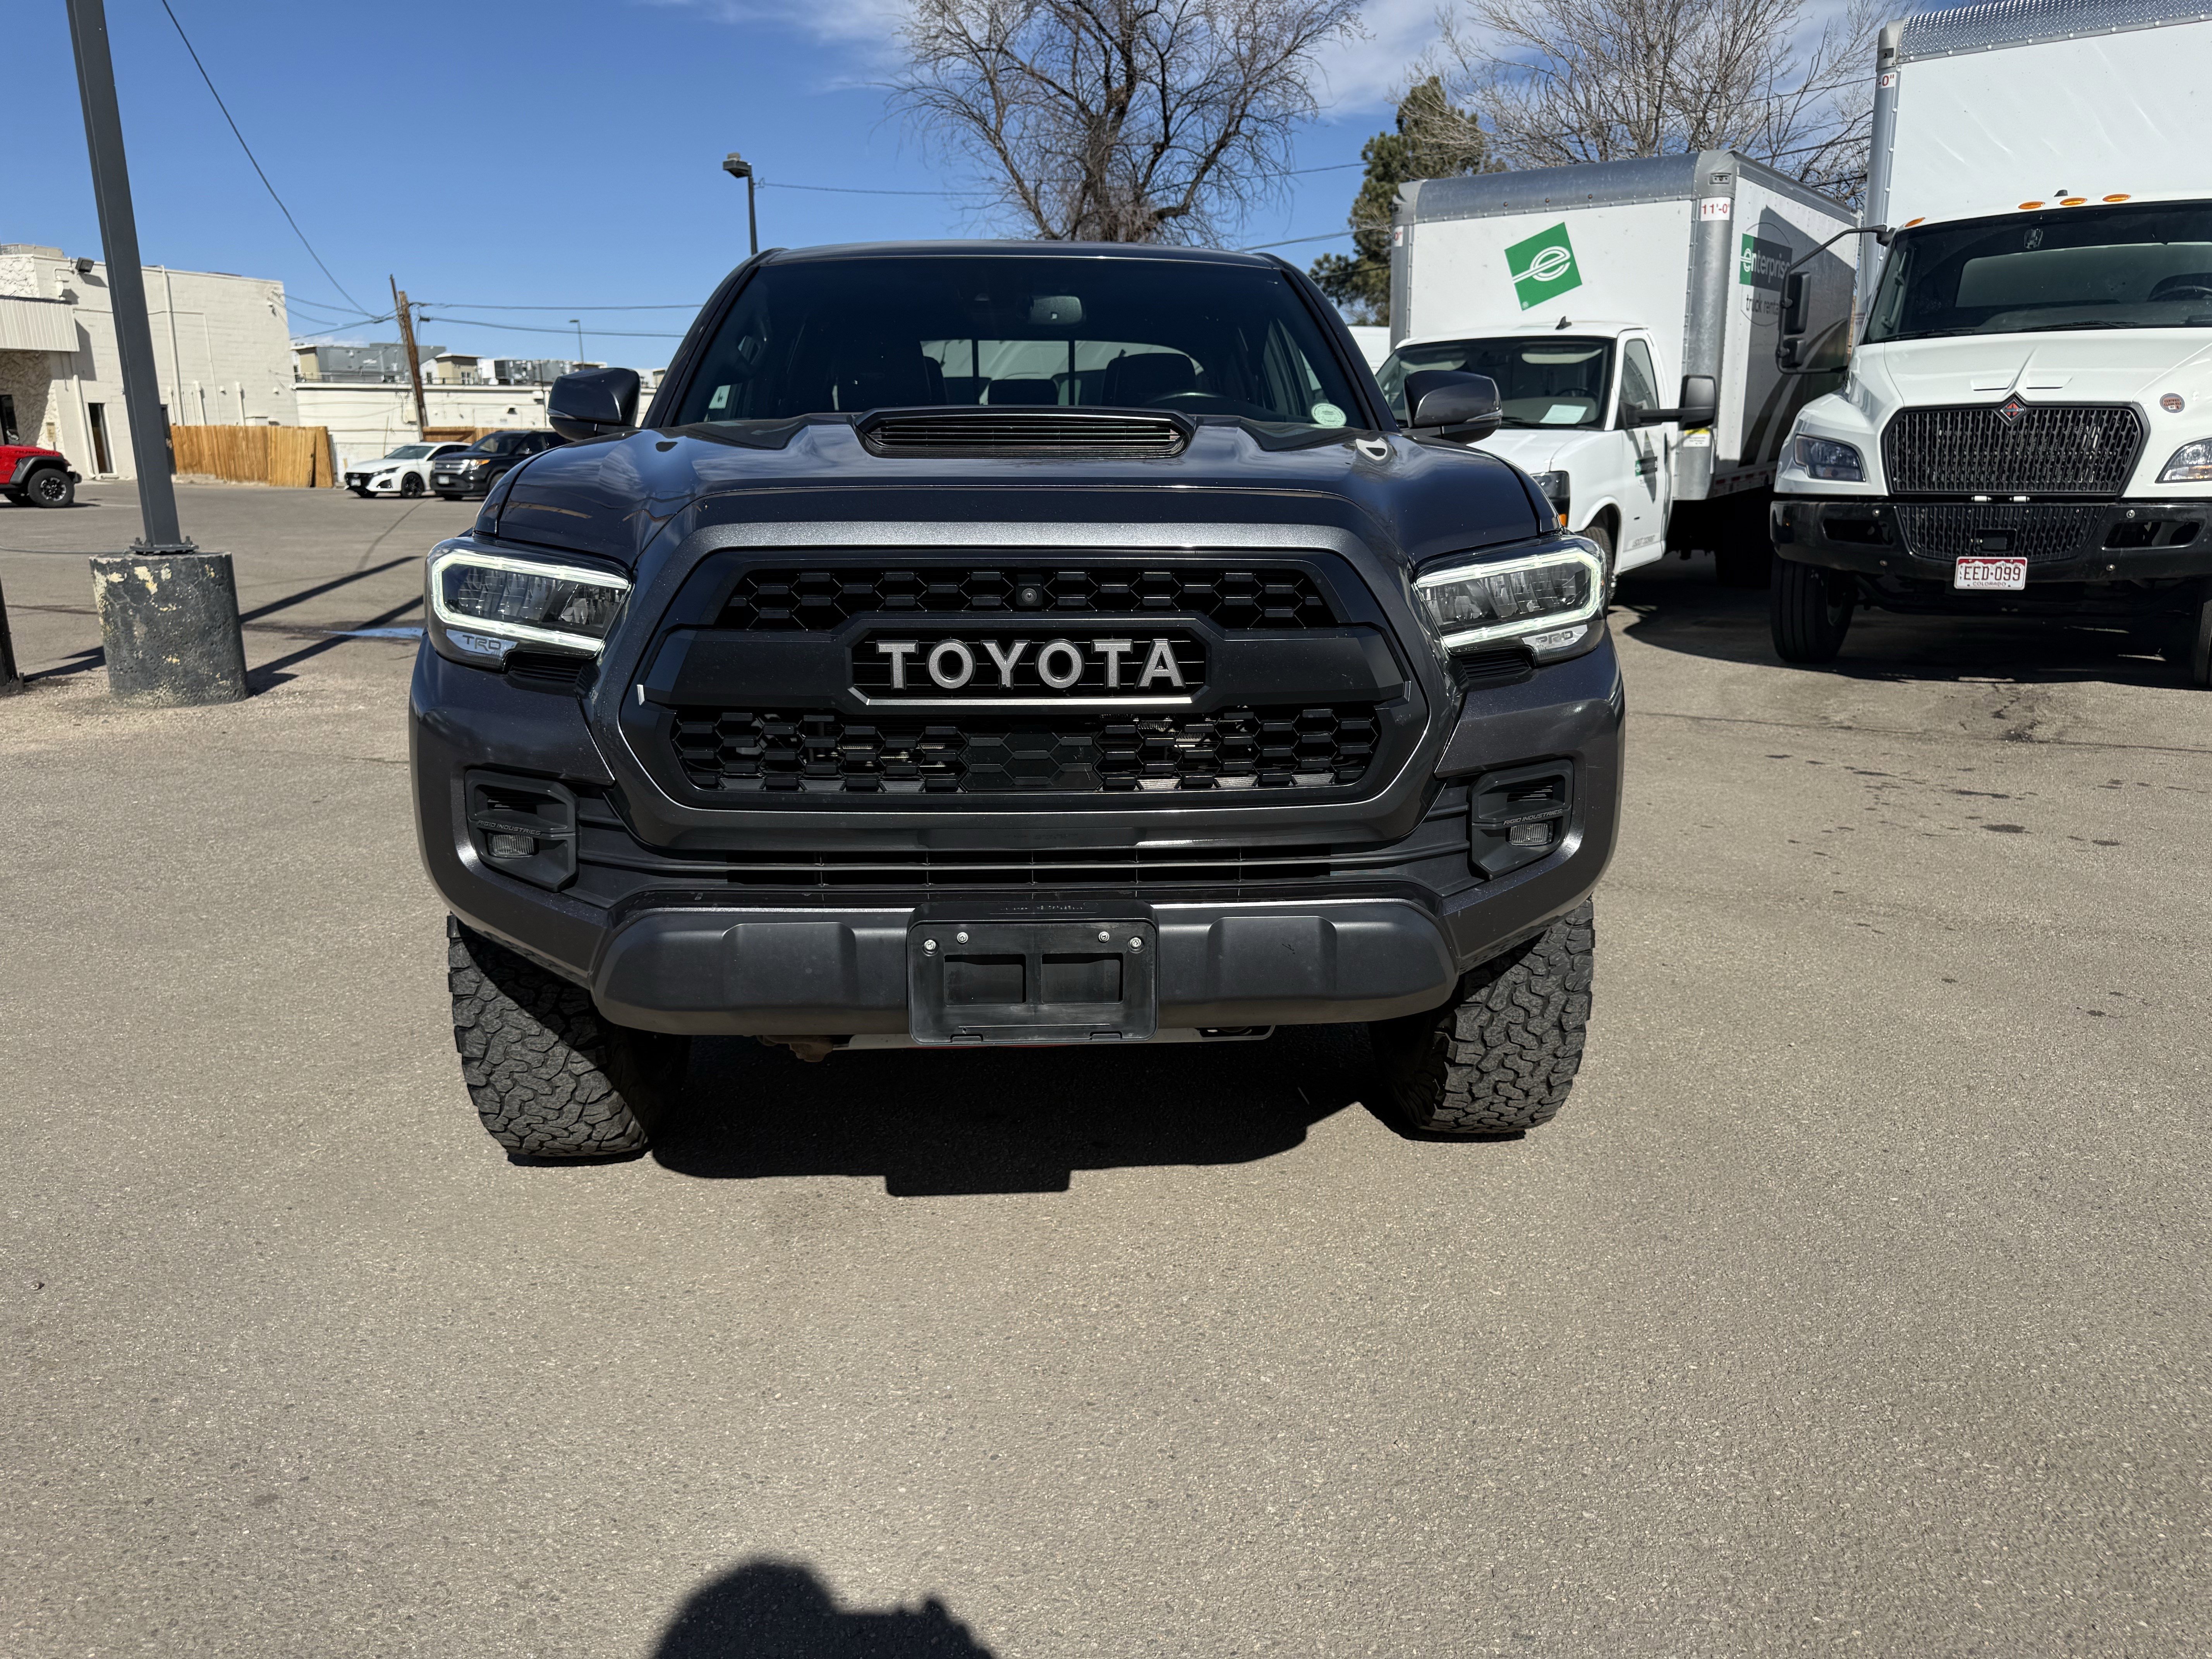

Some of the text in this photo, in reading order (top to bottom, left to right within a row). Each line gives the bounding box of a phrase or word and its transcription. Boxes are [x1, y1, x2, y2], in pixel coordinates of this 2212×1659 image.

[1746, 293, 1779, 315] truck renta
[462, 635, 501, 651] TRD
[1535, 630, 1573, 644] PRO
[876, 639, 1186, 690] TOYOTA
[1522, 809, 1563, 822] INDUSTRIES
[497, 824, 541, 835] INDUSTRIES
